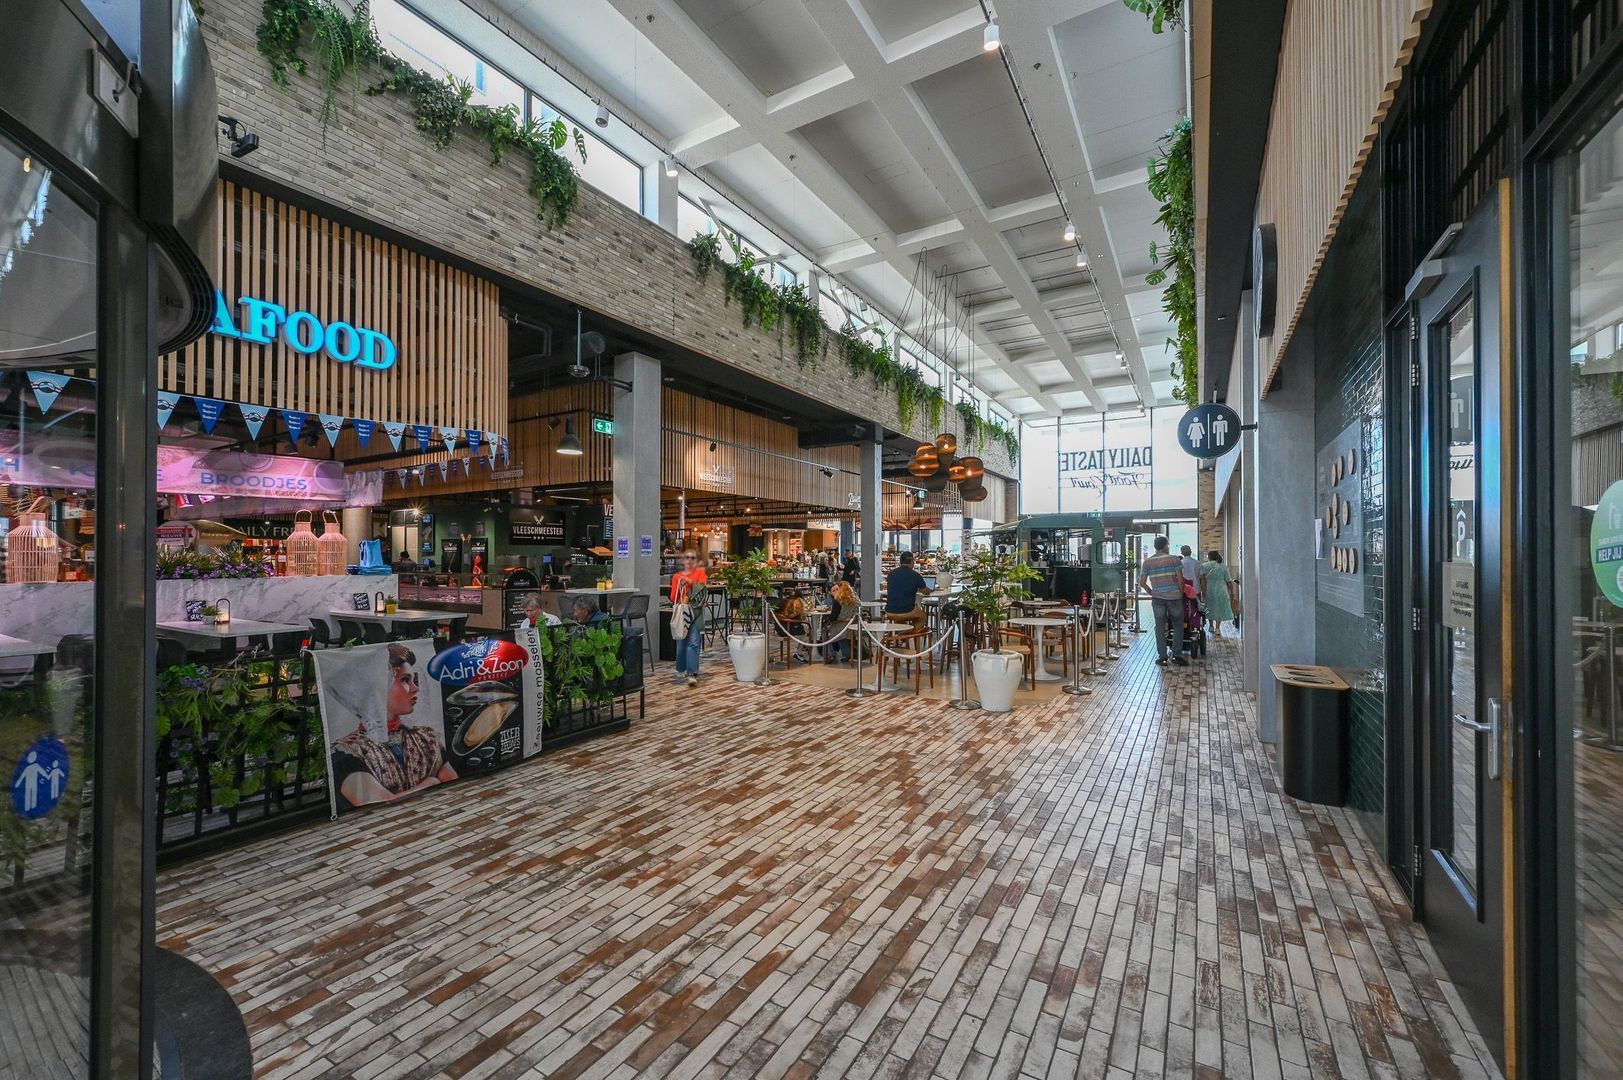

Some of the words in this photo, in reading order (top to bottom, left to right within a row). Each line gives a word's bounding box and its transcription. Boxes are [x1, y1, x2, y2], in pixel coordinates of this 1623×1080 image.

[201, 472, 307, 490] BROODJES
[512, 526, 564, 535] VLEESCHMEESTER
[1598, 548, 1612, 561] HELP
[527, 630, 543, 687] mosselen
